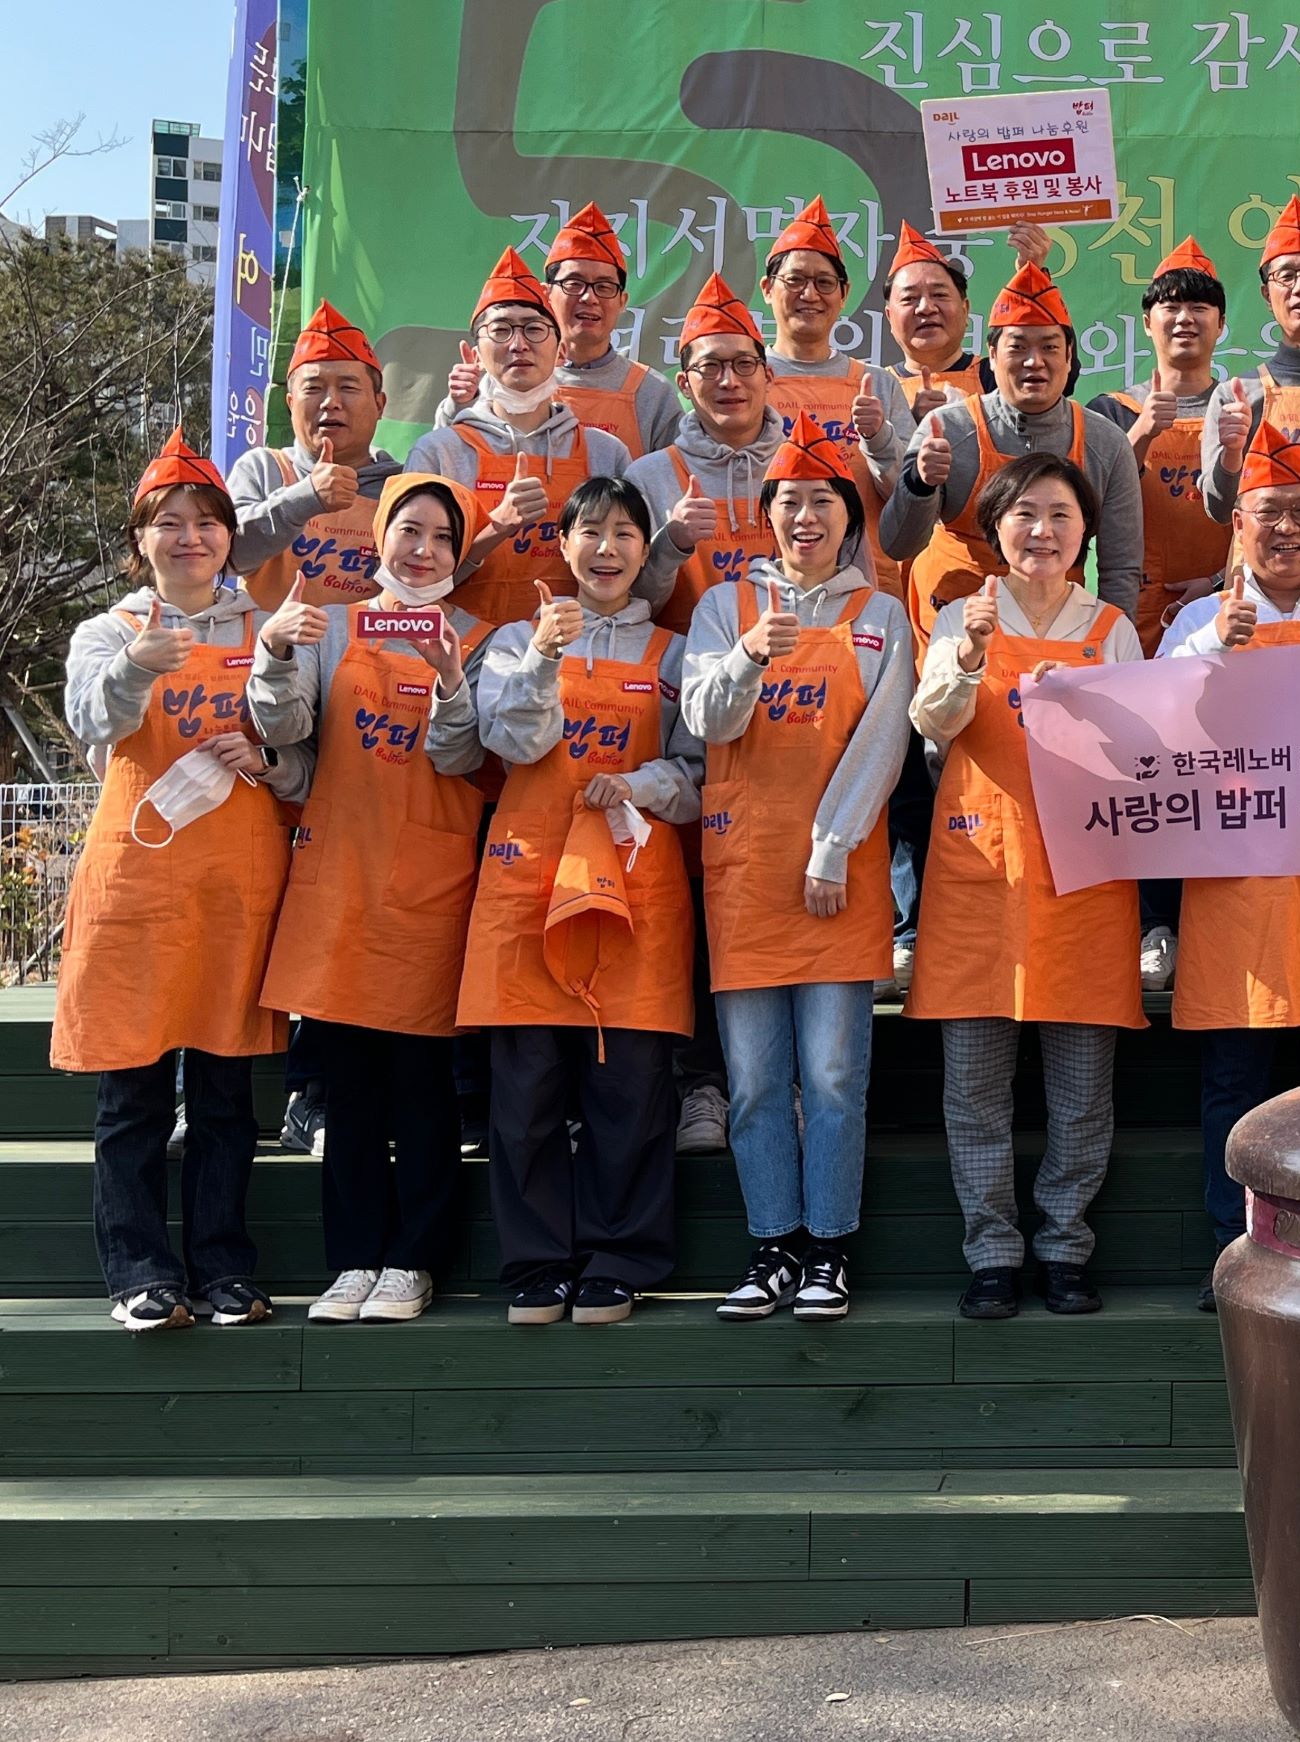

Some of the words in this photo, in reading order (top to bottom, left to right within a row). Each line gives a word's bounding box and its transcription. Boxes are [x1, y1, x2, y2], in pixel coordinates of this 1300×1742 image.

[860, 10, 1165, 93] 진심으로
[948, 127, 990, 143] 사랑의
[997, 125, 1025, 140] 밥퍼
[971, 149, 1066, 172] Lenovo
[945, 182, 999, 204] 노트북
[1003, 179, 1038, 201] 후원
[1044, 178, 1062, 197] 및
[1066, 175, 1103, 196] 봉사
[292, 533, 377, 579] 밥퍼
[324, 575, 372, 594] Babfor
[364, 616, 434, 631] Lenovo
[353, 684, 378, 704] DAIL
[399, 684, 427, 695] Lenovo
[624, 682, 652, 691] Lenovo
[759, 676, 827, 721] 밥퍼
[163, 682, 251, 738] 밥퍼
[562, 697, 580, 709] AIL
[355, 708, 421, 753] 밥퍼
[562, 716, 632, 759] 밥퍼
[1172, 745, 1292, 777] 한국레노버
[1084, 787, 1202, 837] 사랑의
[1215, 785, 1287, 830] 밥퍼
